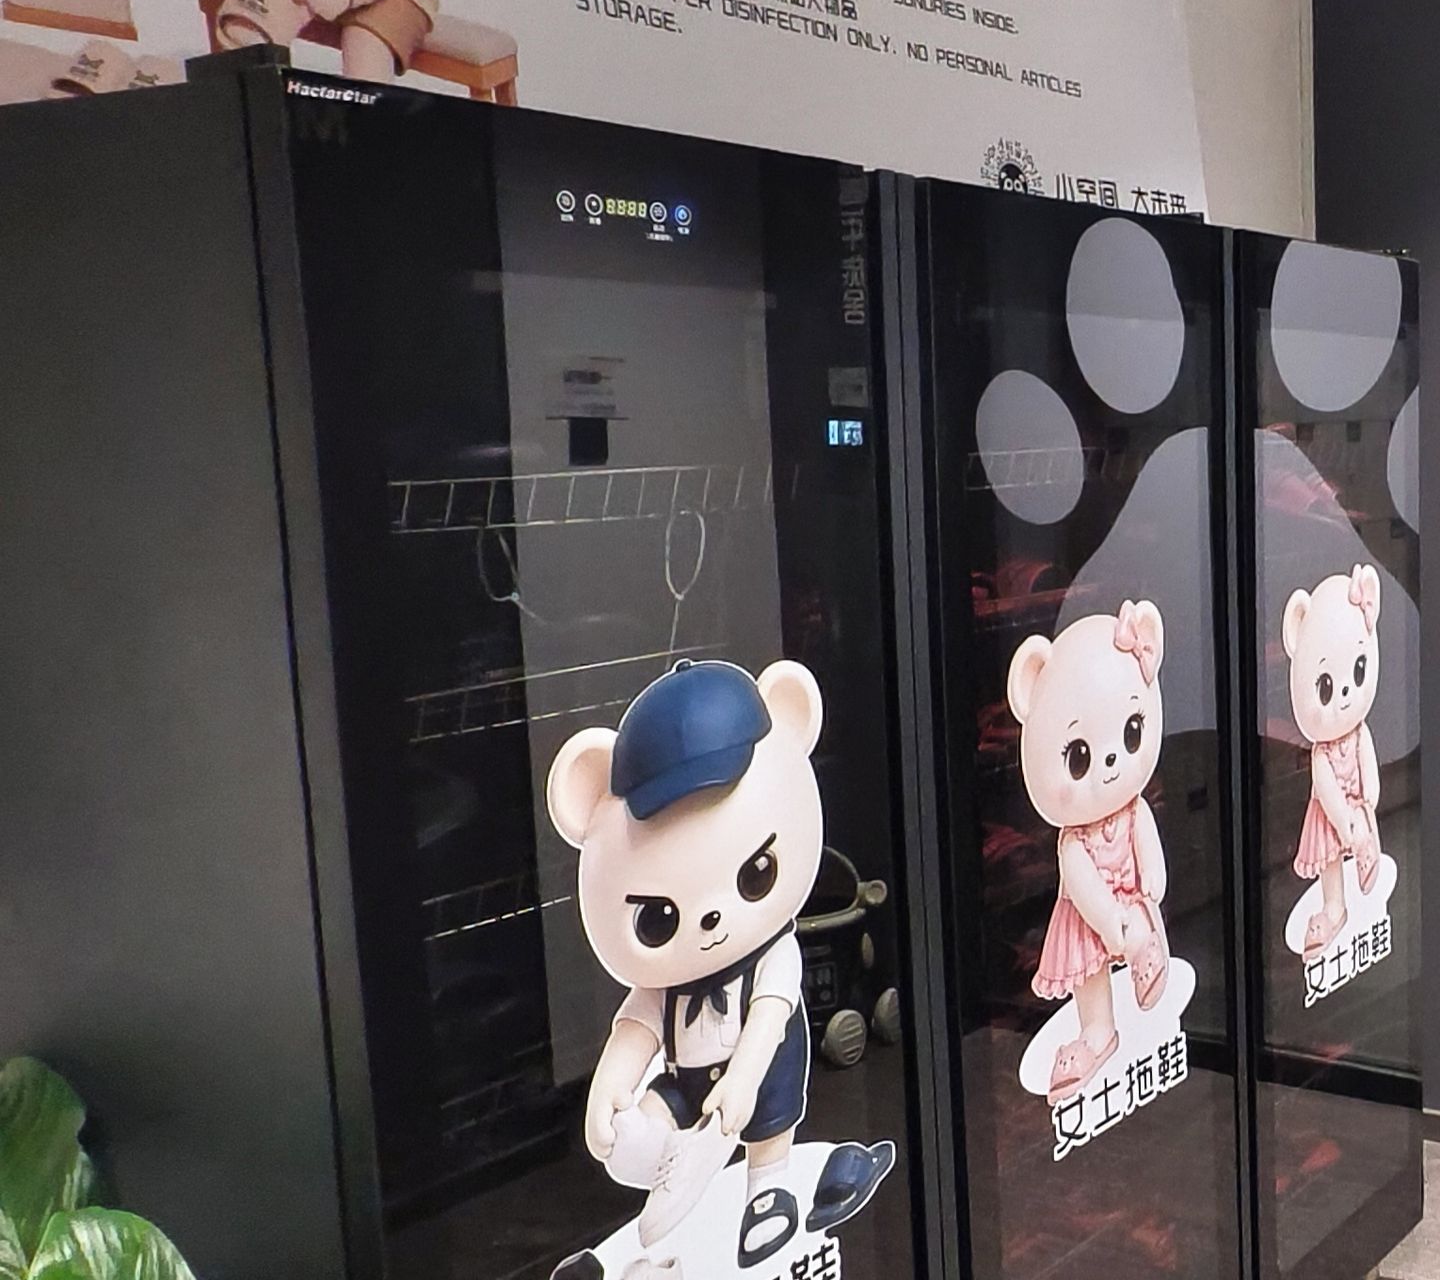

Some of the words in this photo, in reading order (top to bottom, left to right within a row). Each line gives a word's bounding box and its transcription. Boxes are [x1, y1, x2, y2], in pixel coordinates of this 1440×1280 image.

[907, 42, 929, 63] NO
[936, 48, 1013, 82] PERSONAL
[1020, 69, 1081, 98] ARTICLES
[1306, 919, 1389, 1002] 女士拖鞋
[1056, 1036, 1185, 1154] 女士拖鞋
